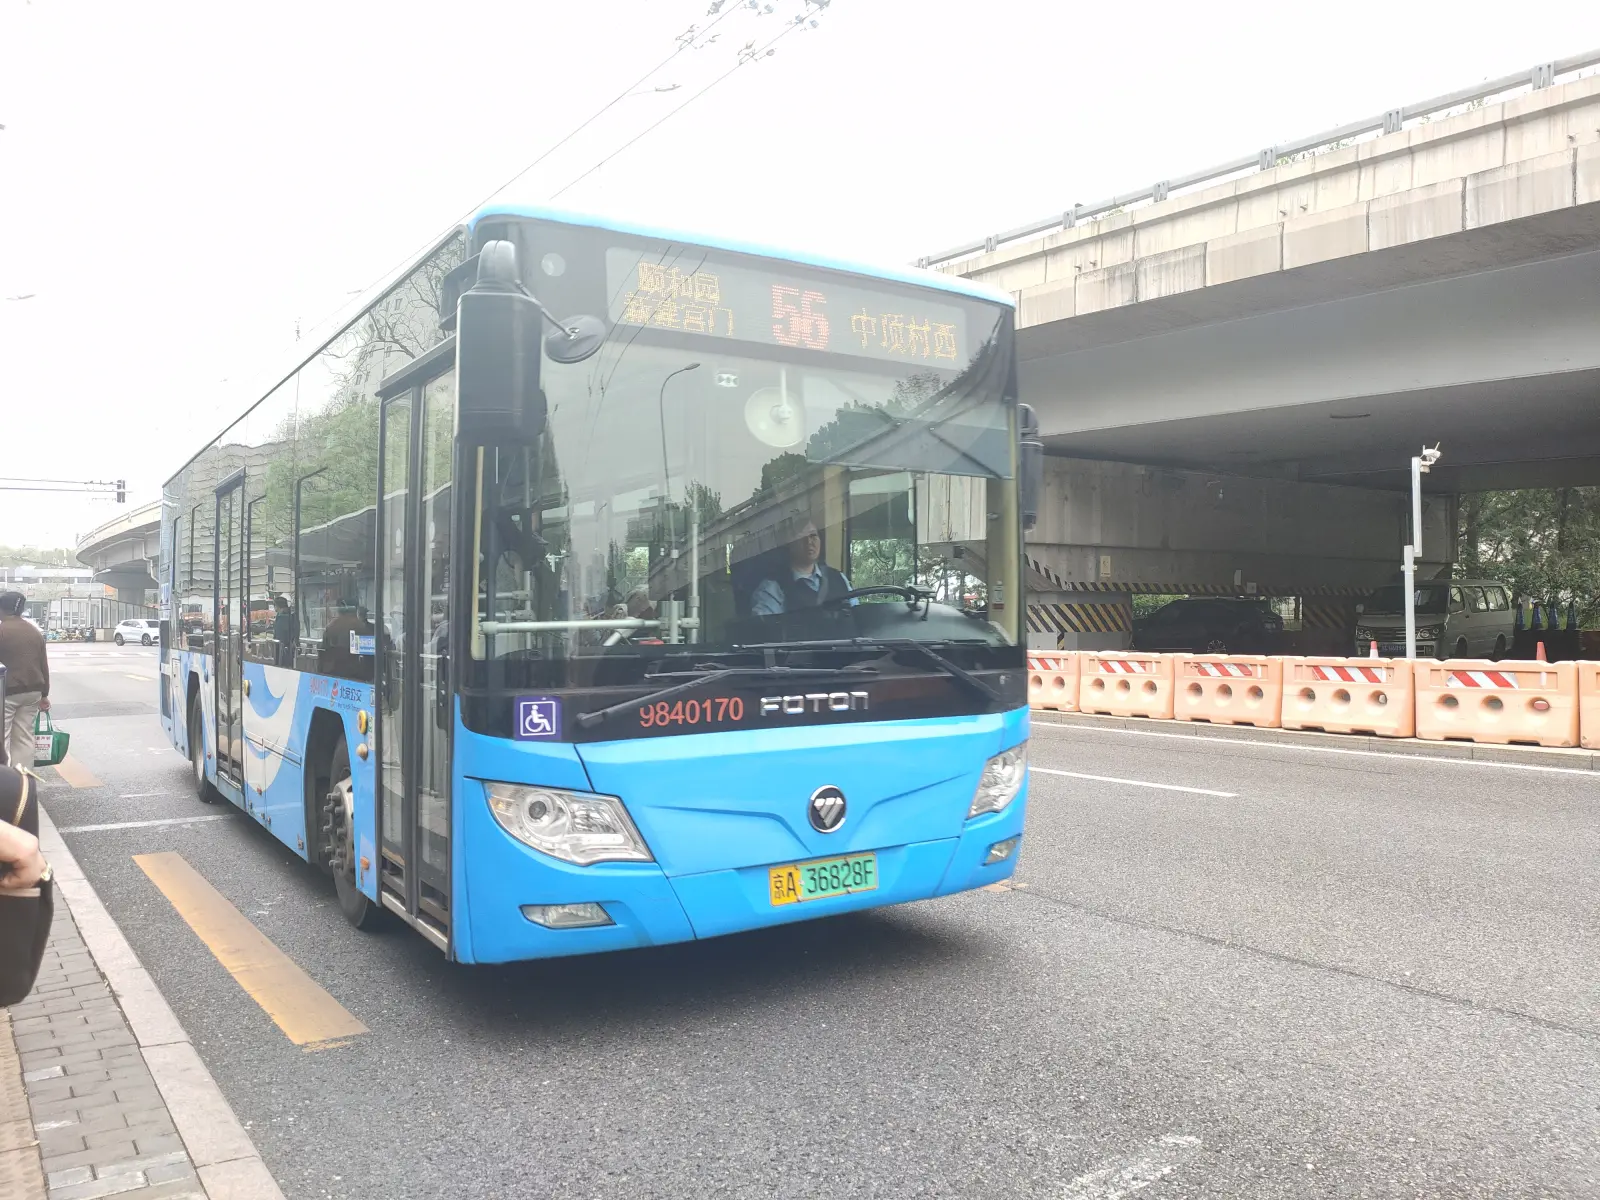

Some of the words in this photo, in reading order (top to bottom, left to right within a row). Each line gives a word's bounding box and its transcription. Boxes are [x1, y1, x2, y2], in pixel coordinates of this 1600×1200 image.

[771, 284, 830, 350] 56
[850, 307, 957, 360] 中顶村西
[340, 685, 362, 702] 北京公交
[760, 691, 869, 717] FOTON
[639, 697, 744, 728] 9840170
